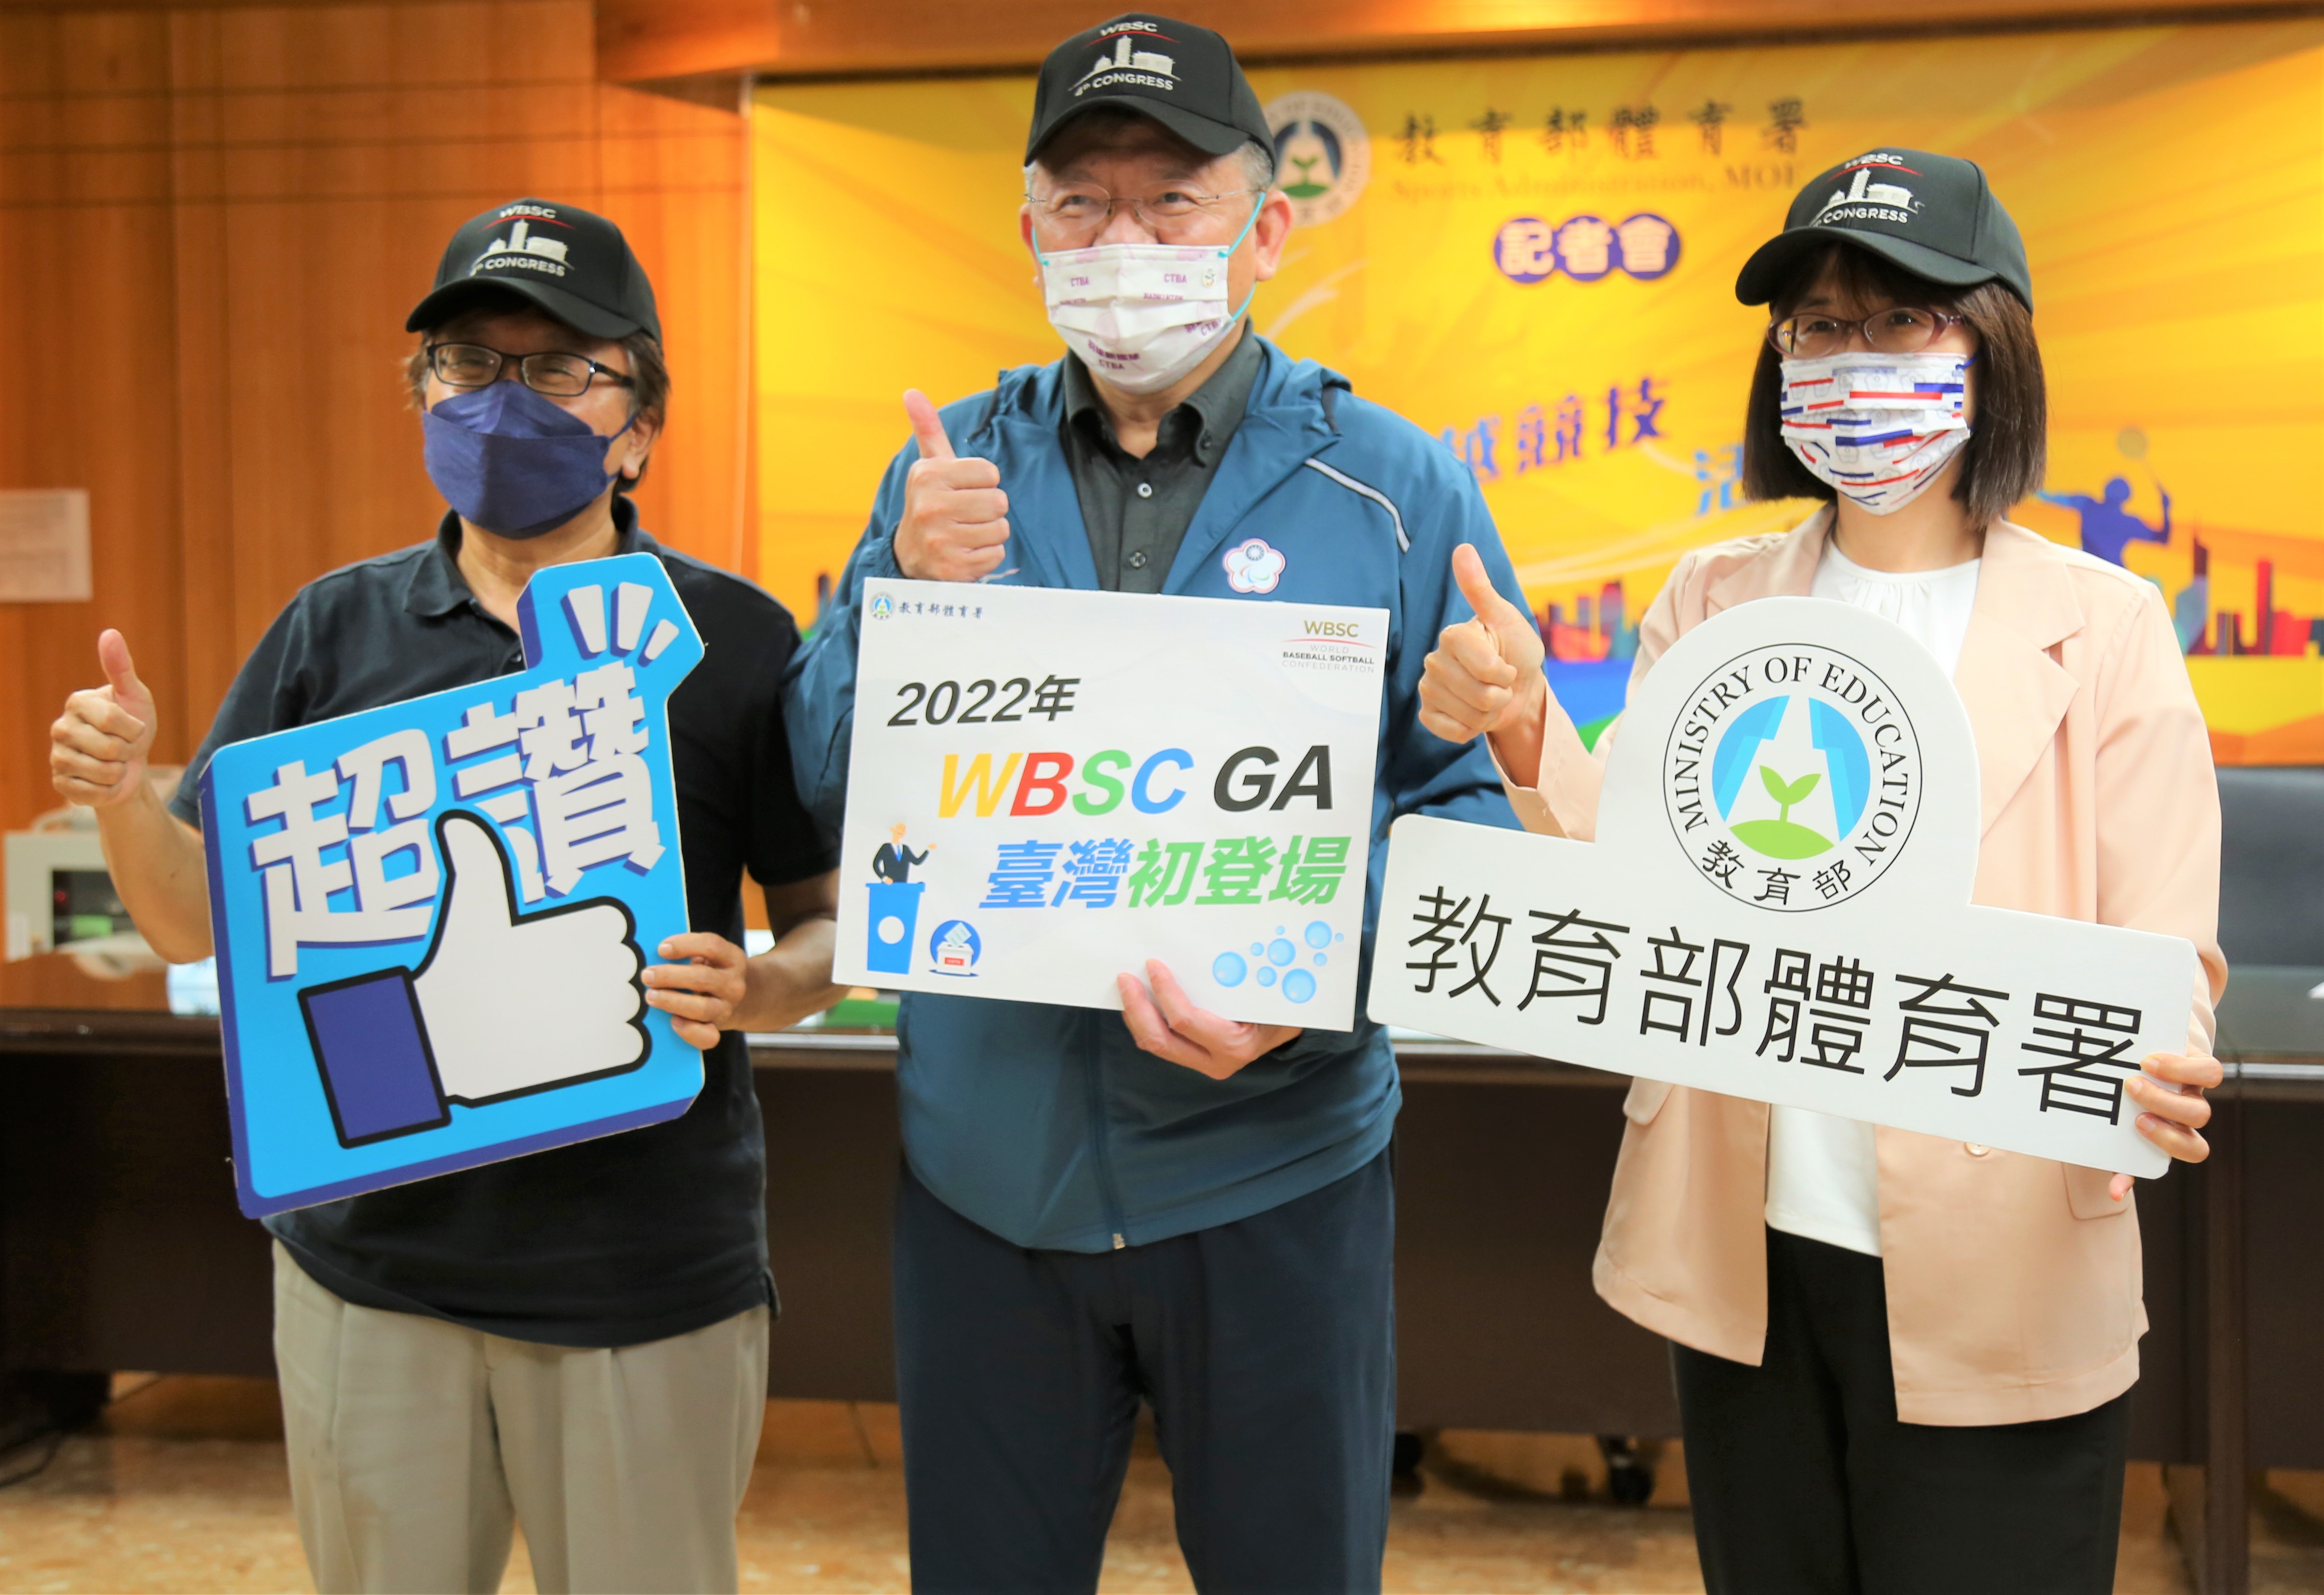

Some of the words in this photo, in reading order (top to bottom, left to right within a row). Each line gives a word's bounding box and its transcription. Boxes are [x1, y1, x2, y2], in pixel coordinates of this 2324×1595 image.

[1100, 21, 1158, 37] WBSC
[1092, 73, 1174, 91] CONGRESS
[1392, 95, 1809, 166] 教育部體育署
[500, 205, 556, 218] WBSC
[1823, 207, 1908, 224] CONGRESS
[1497, 213, 1673, 278] 記者會
[484, 256, 565, 277] CONGRESS
[1070, 276, 1090, 287] CTBA
[1164, 274, 1187, 283] CTBA
[1099, 358, 1125, 370] CTBA
[899, 600, 983, 619] 教育部體育署
[1304, 620, 1359, 637] WBSC
[1283, 651, 1328, 661] BASEBALL
[1329, 654, 1375, 665] SOFTBALL
[1310, 644, 1350, 654] WORLD
[1282, 660, 1375, 673] CONFEDERATION
[887, 674, 1081, 727] 2022年
[1674, 665, 1755, 834] MINISTRY
[1765, 656, 1813, 684] OF
[1818, 662, 1909, 867] EDUCATION
[937, 748, 1194, 818] WBSC
[1213, 745, 1333, 813] GA
[243, 660, 667, 982] 超讚
[978, 835, 1352, 909] 臺灣初登場
[1702, 839, 1852, 906] 教育部
[1404, 884, 2144, 1128] 教育部體育署
